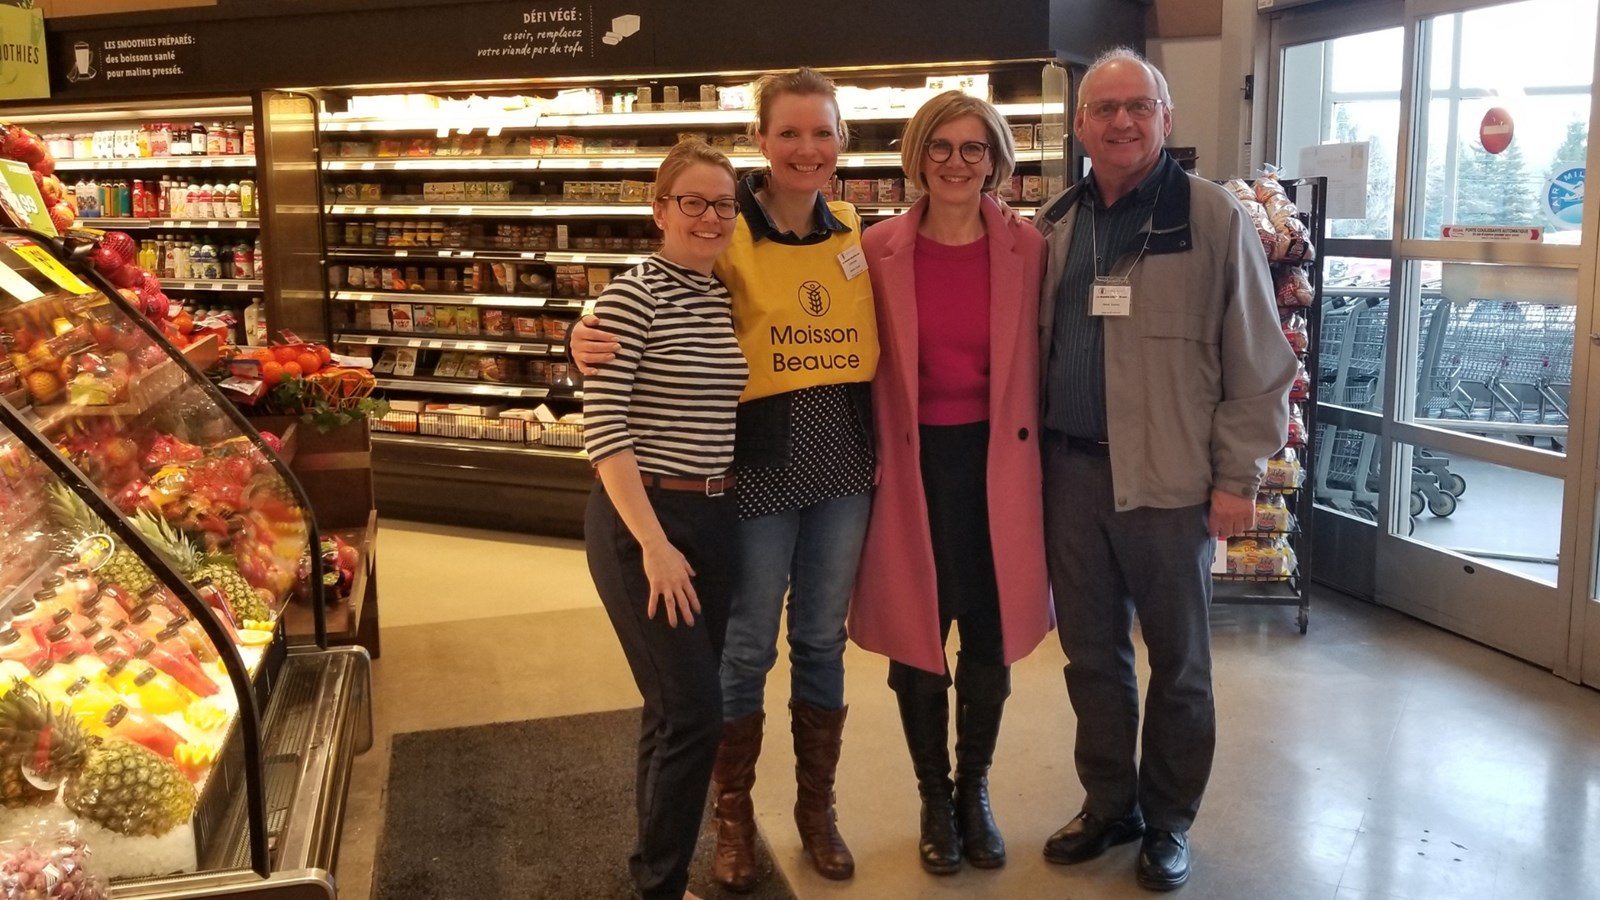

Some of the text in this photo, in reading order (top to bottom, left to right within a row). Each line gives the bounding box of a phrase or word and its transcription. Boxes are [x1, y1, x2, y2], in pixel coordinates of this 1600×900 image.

[523, 9, 547, 24] DÉFI
[514, 29, 534, 42] soir,
[537, 26, 583, 43] remplacez
[104, 40, 116, 50] LES
[117, 38, 157, 49] SMOOTHIES
[477, 41, 584, 59] votre viande par du tofu
[105, 50, 176, 64] des boissons santé
[106, 70, 124, 80] pour
[1551, 187, 1560, 207] AIR
[770, 325, 858, 345] Moisson
[773, 352, 860, 372] Beauce
